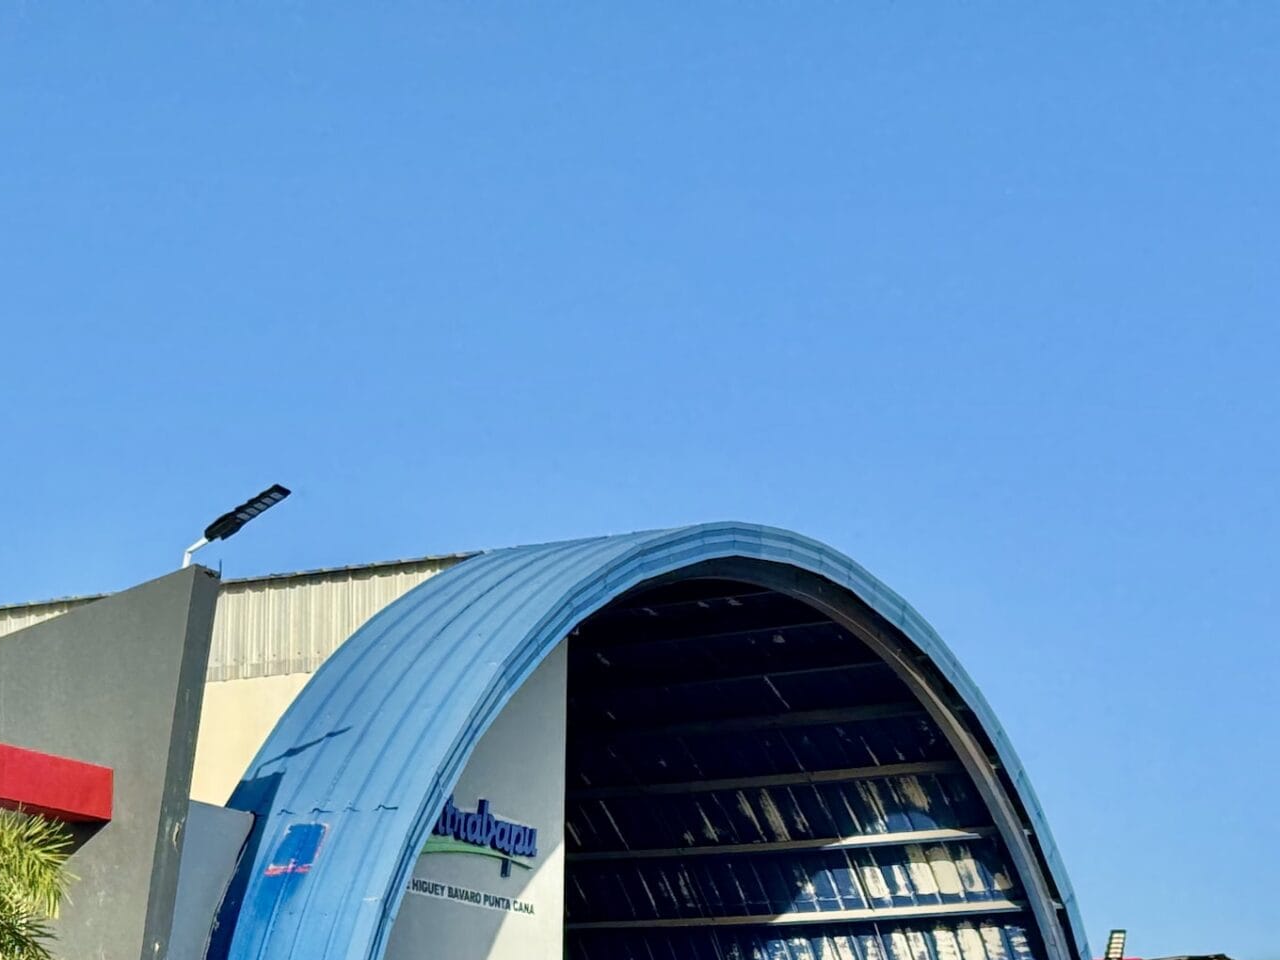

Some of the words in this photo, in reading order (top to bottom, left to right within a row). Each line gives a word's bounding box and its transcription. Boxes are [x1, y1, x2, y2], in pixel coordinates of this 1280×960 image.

[412, 879, 445, 896] HIGUEY
[448, 887, 481, 904] BAVARO
[483, 894, 511, 910] PUNTA
[513, 900, 535, 915] CANA
